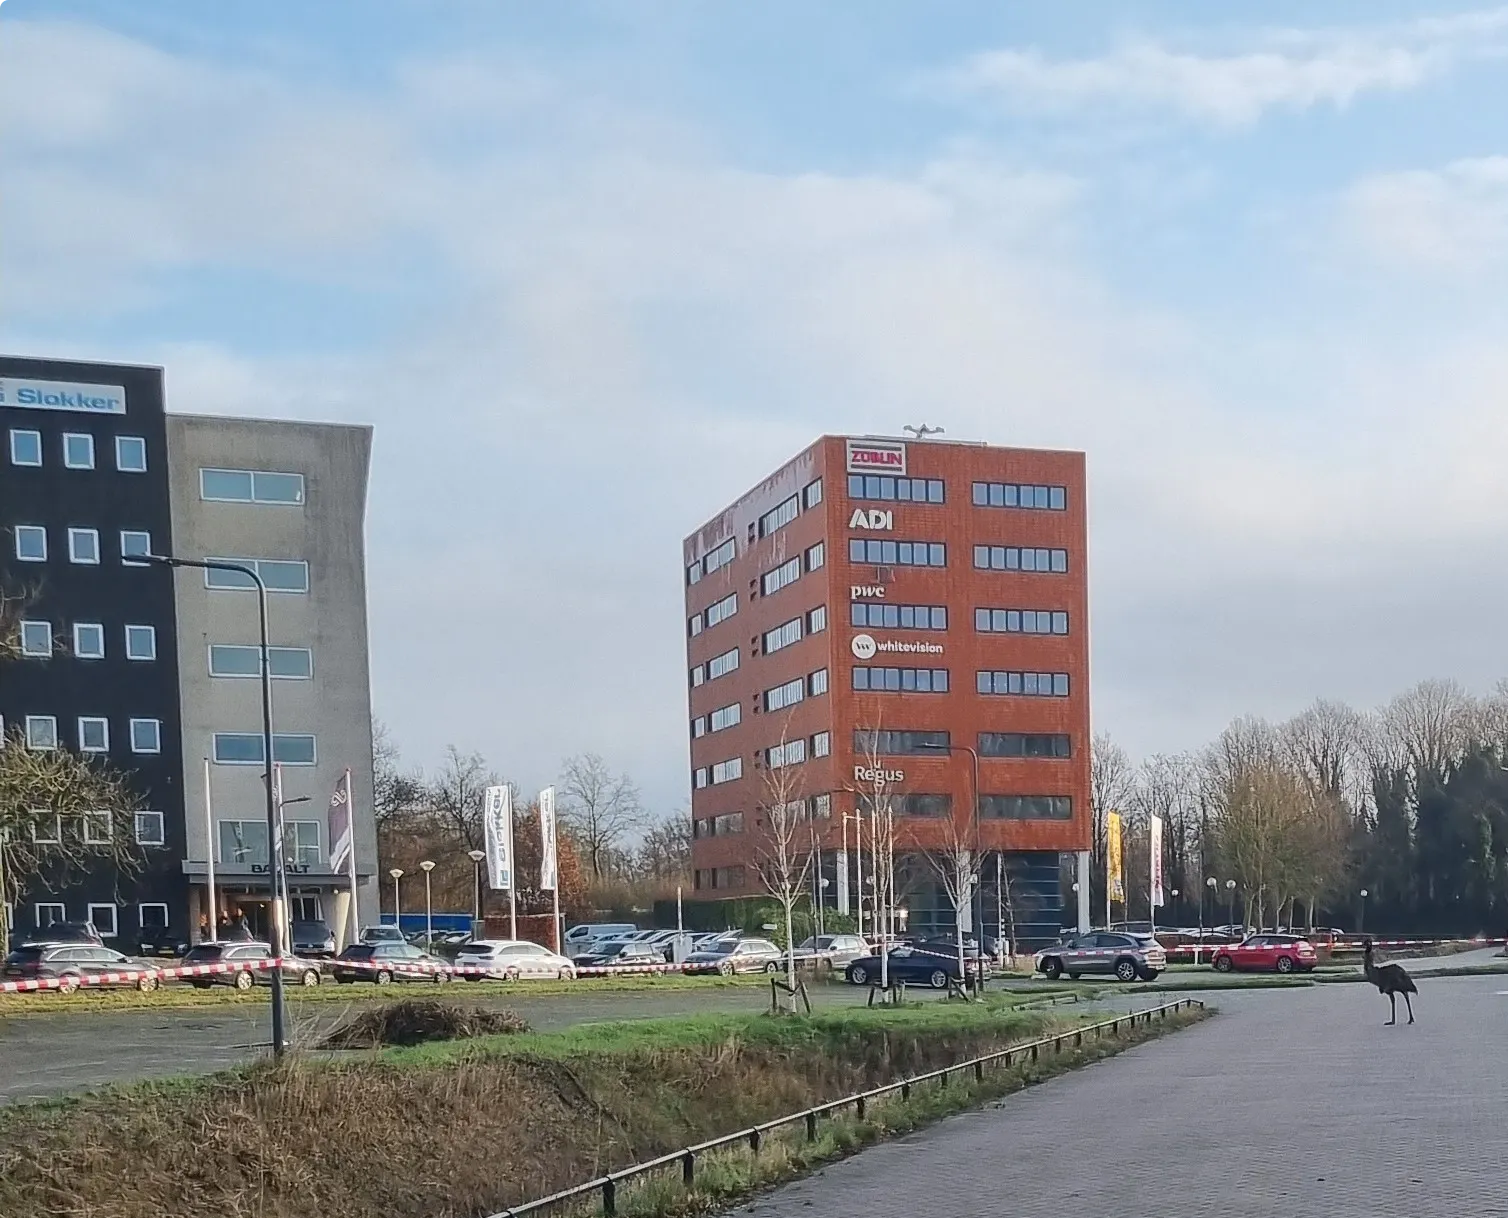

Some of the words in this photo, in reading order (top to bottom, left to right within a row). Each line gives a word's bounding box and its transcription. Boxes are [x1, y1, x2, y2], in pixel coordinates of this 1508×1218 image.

[17, 388, 120, 409] Slokker
[849, 508, 893, 530] ADI
[850, 585, 885, 600] pwc
[877, 640, 943, 653] whitevision
[854, 765, 904, 787] Regus
[251, 864, 310, 874] BAALT
